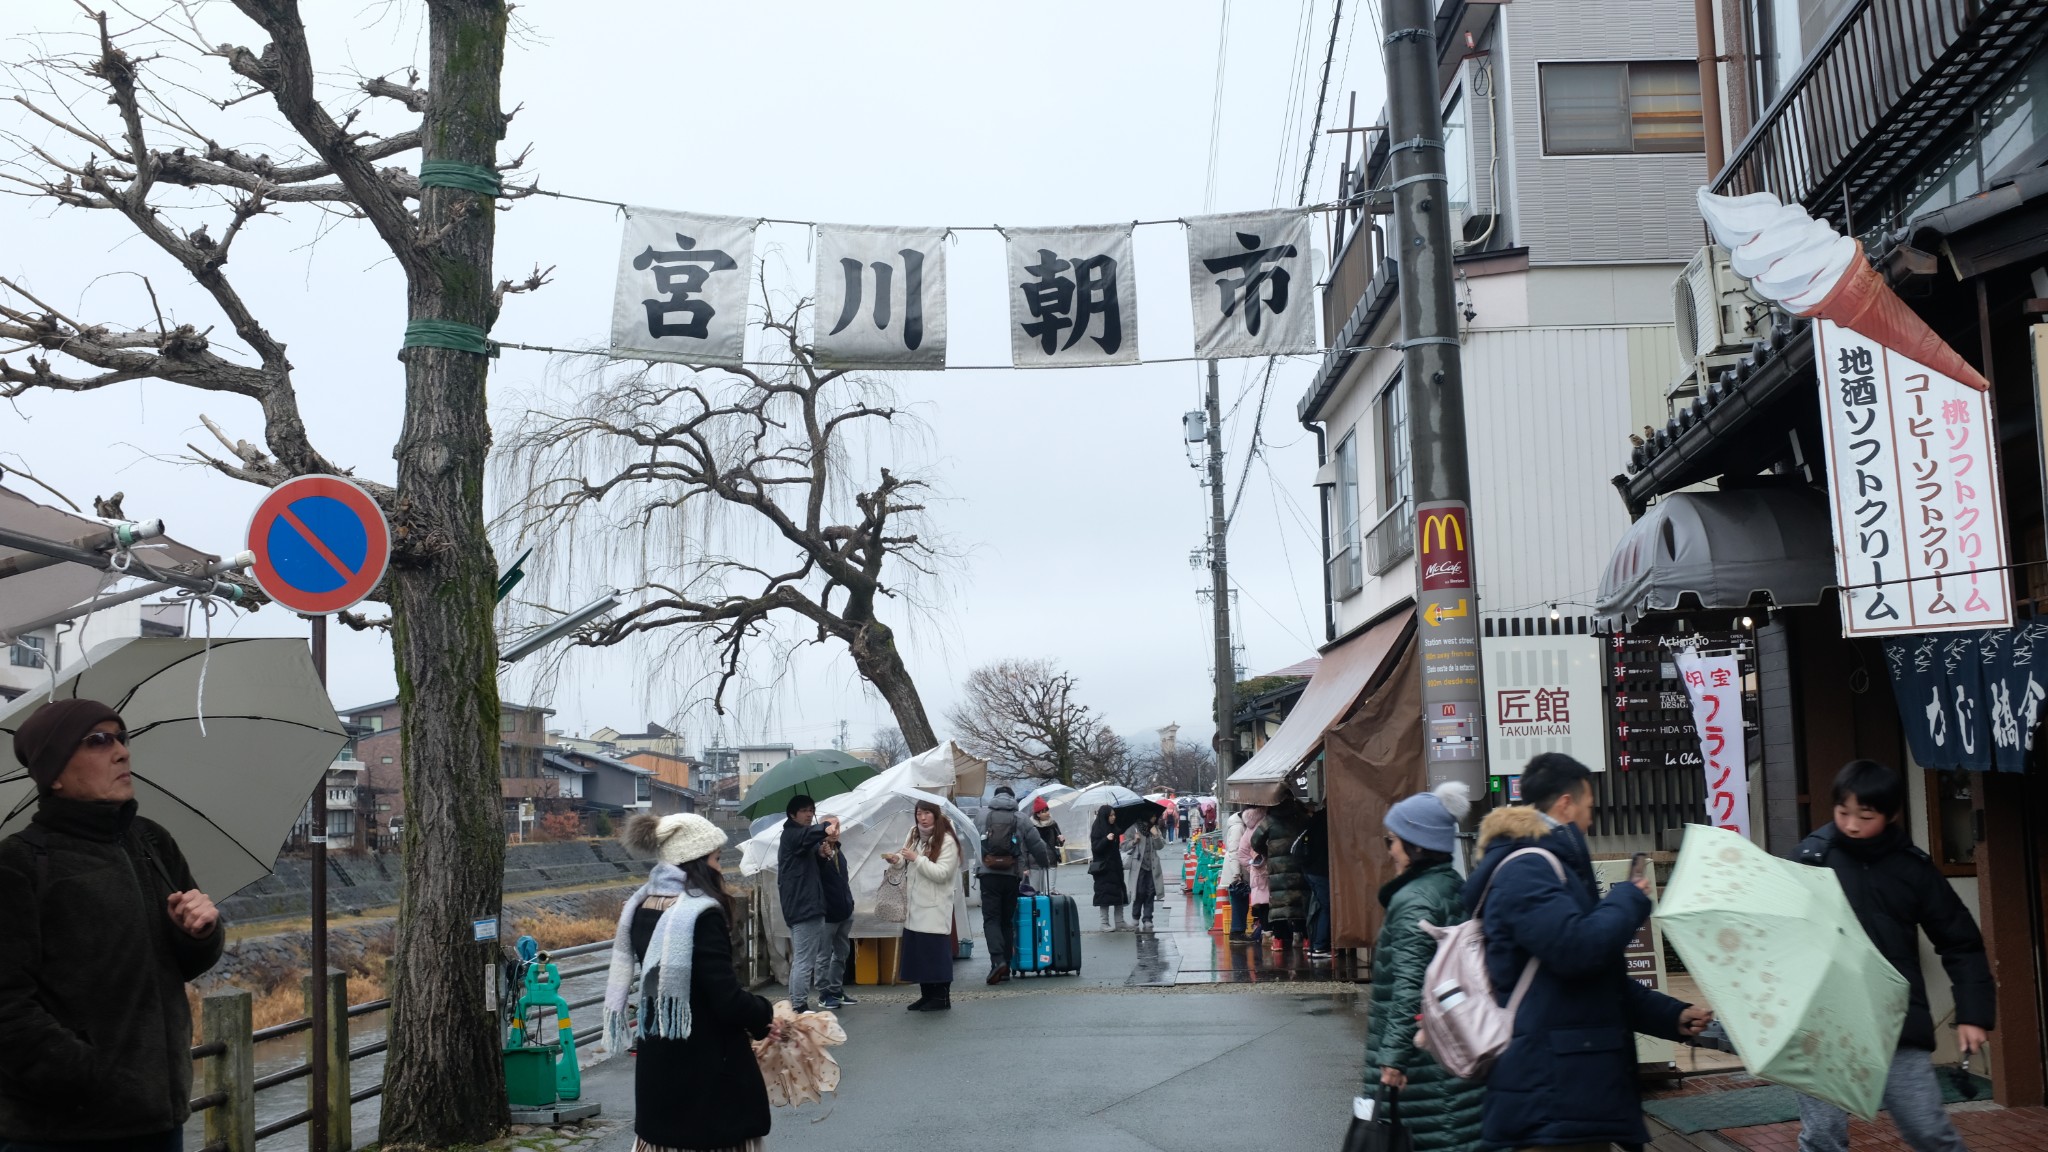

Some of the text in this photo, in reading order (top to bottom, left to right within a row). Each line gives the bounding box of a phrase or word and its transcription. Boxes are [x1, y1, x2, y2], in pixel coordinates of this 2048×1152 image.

[1838, 346, 1899, 621] 地酒ソフトクリーム
[1905, 373, 1956, 614] コーヒーソフトクリーム
[1942, 399, 1990, 612] 桃ソフトクリーム
[1424, 638, 1442, 647] Station
[1443, 637, 1457, 645] west
[1612, 637, 1625, 648] 3F
[1614, 666, 1627, 677] 3F
[1498, 687, 1570, 725] 匠館
[1615, 696, 1628, 707] 2F
[1499, 725, 1571, 737] TAKUMI-KAN
[1617, 726, 1629, 737] 1F
[1660, 726, 1680, 734] HIDA
[1619, 755, 1631, 767] 1F
[1665, 753, 1677, 765] La
